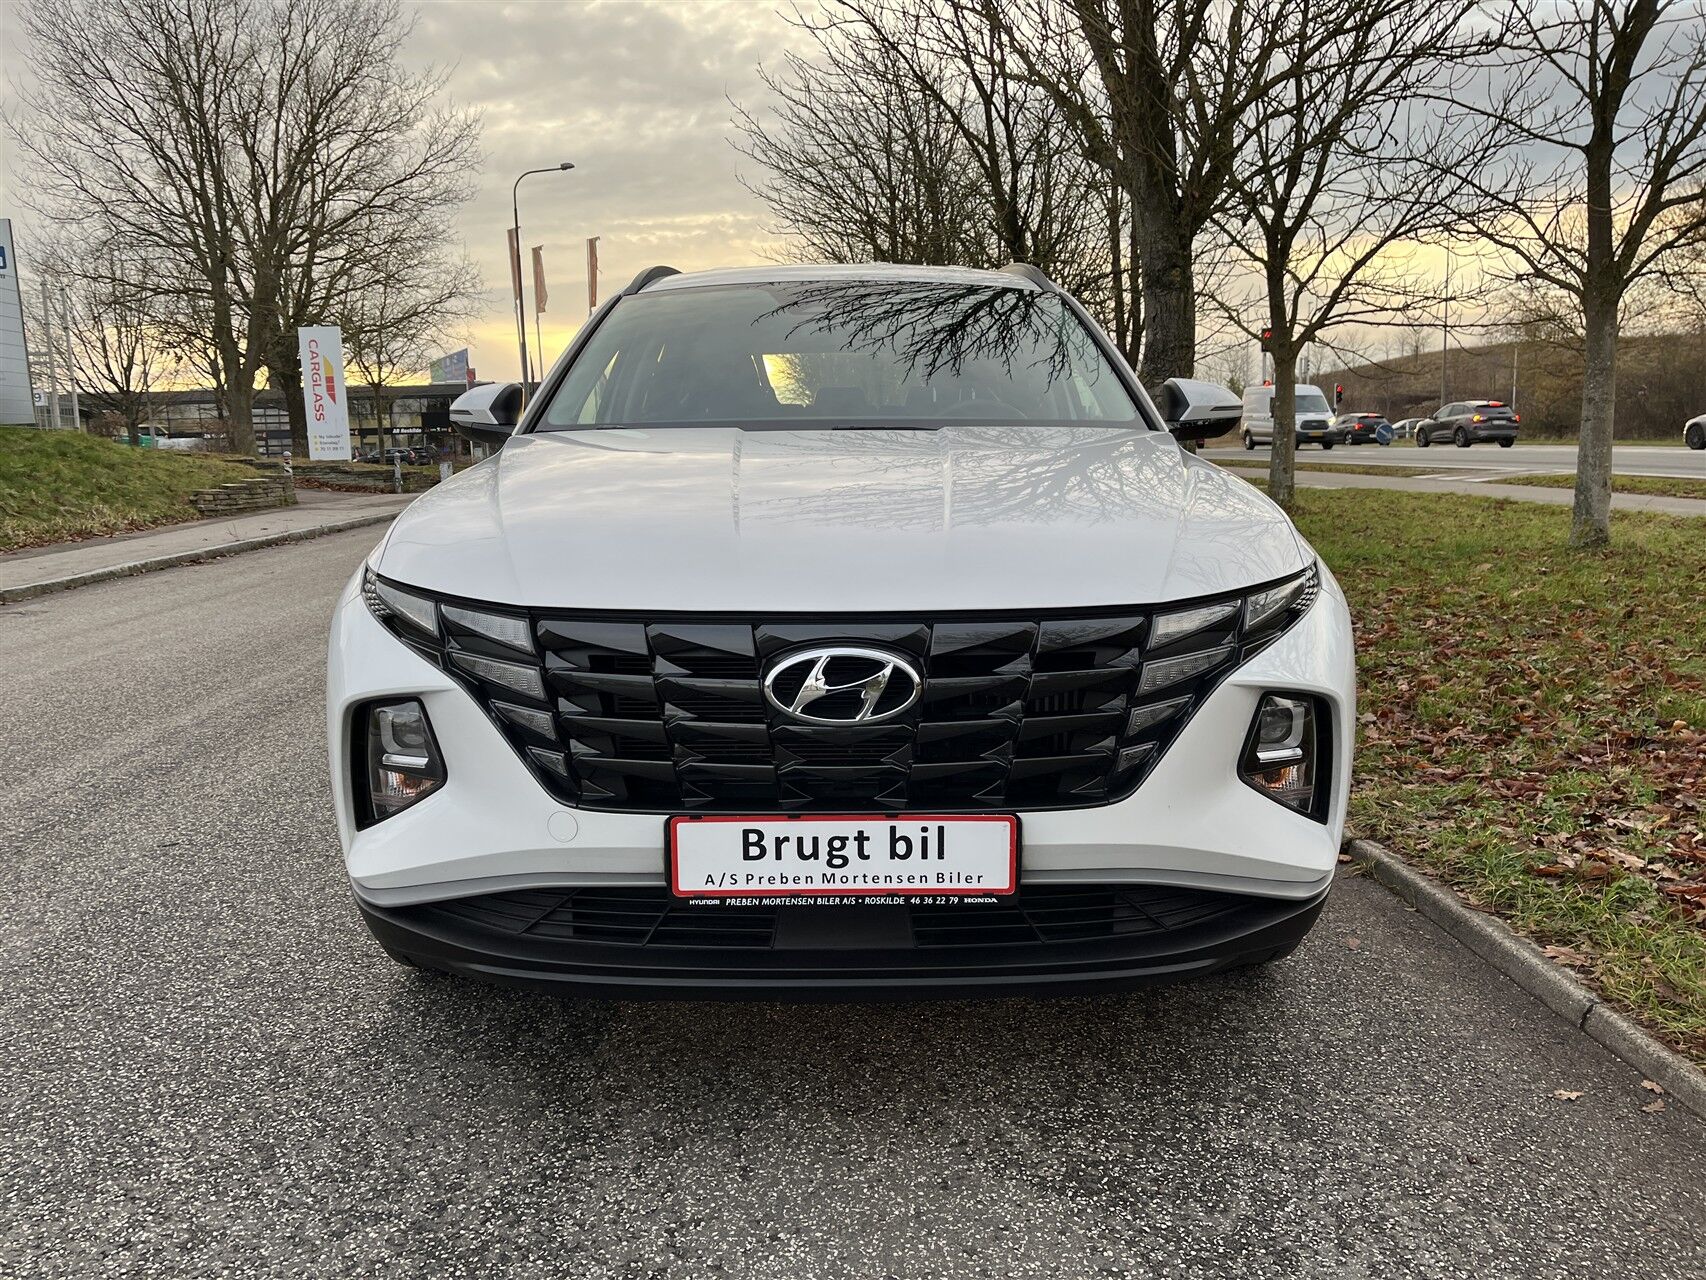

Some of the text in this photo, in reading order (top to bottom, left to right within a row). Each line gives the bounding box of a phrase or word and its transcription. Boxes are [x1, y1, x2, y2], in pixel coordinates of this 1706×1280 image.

[308, 339, 325, 422] CARGLASS
[742, 825, 945, 869] Brugt bil
[704, 871, 984, 888] A/S Preben Mortensen Biler
[725, 897, 759, 906] PREBEN
[761, 897, 814, 906] MORTENSEN
[816, 896, 840, 905] BILER
[842, 896, 856, 905] A/S
[864, 896, 905, 905] ROSKILDE
[910, 896, 921, 905] 46
[923, 896, 933, 905] 36
[935, 896, 946, 905] 22
[948, 896, 959, 905] 79
